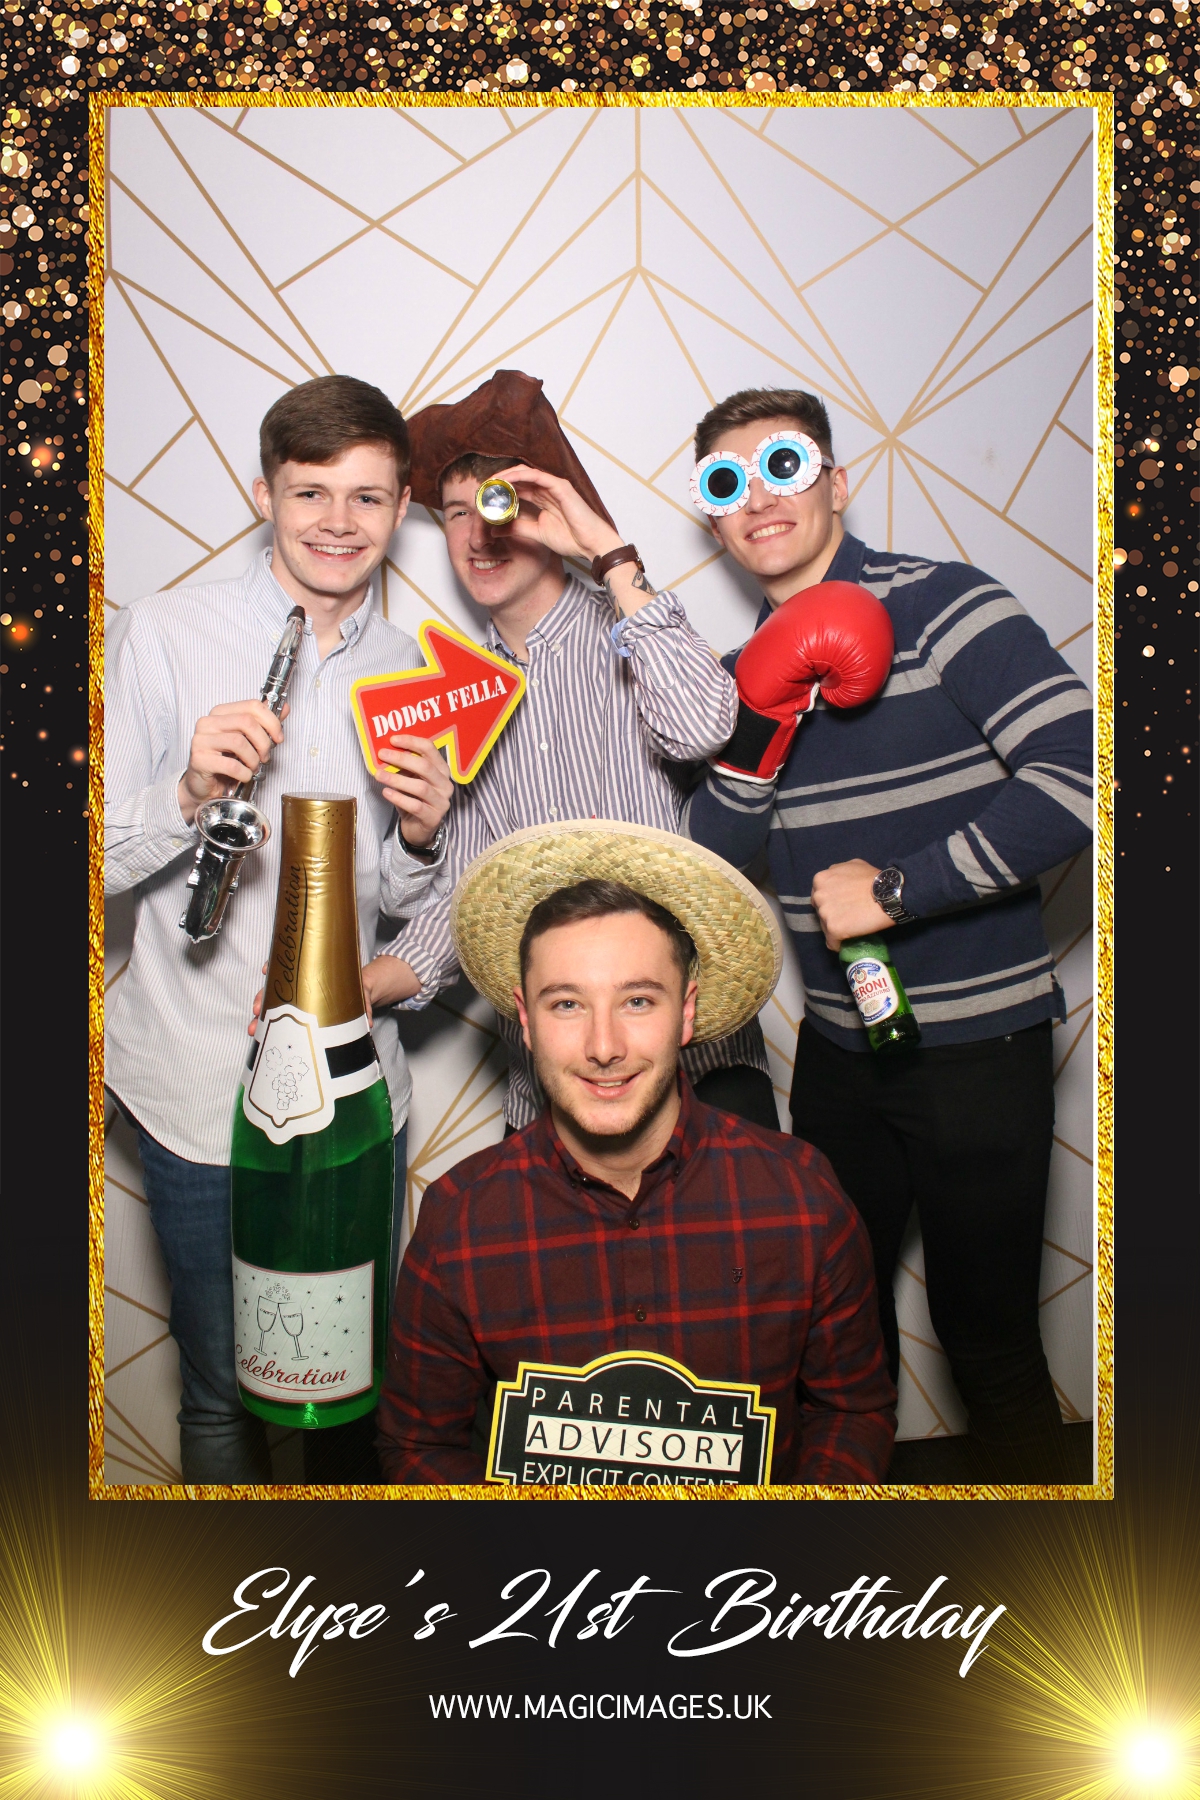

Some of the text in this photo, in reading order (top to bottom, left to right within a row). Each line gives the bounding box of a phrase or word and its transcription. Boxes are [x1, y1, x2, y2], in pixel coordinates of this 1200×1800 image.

[372, 675, 508, 738] DODGY FELLA
[273, 862, 302, 1004] Celebration
[532, 1387, 743, 1427] PARENTAL
[526, 1420, 742, 1466] ADVISORY
[522, 1461, 623, 1485] EXPLICIT
